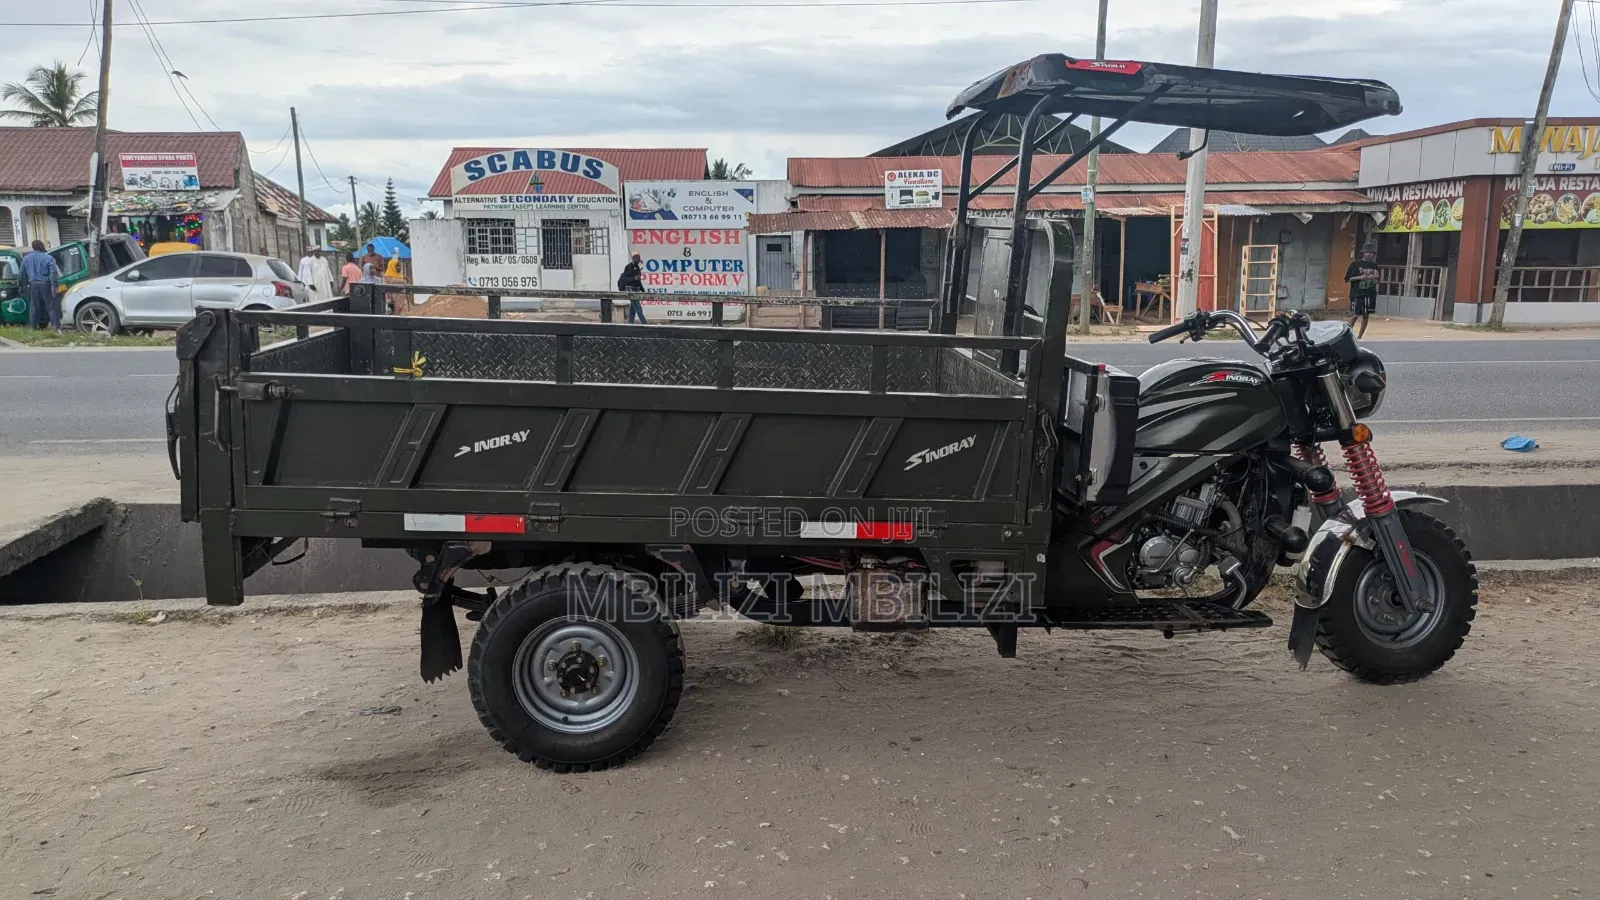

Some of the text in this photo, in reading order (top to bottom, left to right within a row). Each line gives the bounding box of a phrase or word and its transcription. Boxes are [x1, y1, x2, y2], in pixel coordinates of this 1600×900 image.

[1488, 126, 1600, 159] MWAJ
[463, 150, 604, 181] SCABUS
[1552, 163, 1574, 171] Wi-Fi
[927, 170, 939, 178] DC
[1366, 180, 1467, 203] MWAJA RESTAURAN
[500, 195, 575, 203] SECONDARY
[632, 229, 740, 244] ENGLISH
[683, 247, 692, 257] &
[466, 255, 480, 266] Reg.
[480, 255, 491, 264] No.
[640, 259, 745, 272] OMPUTER
[479, 276, 538, 287] 0713 056 976
[731, 273, 745, 286] V
[904, 434, 977, 471] SINORAY
